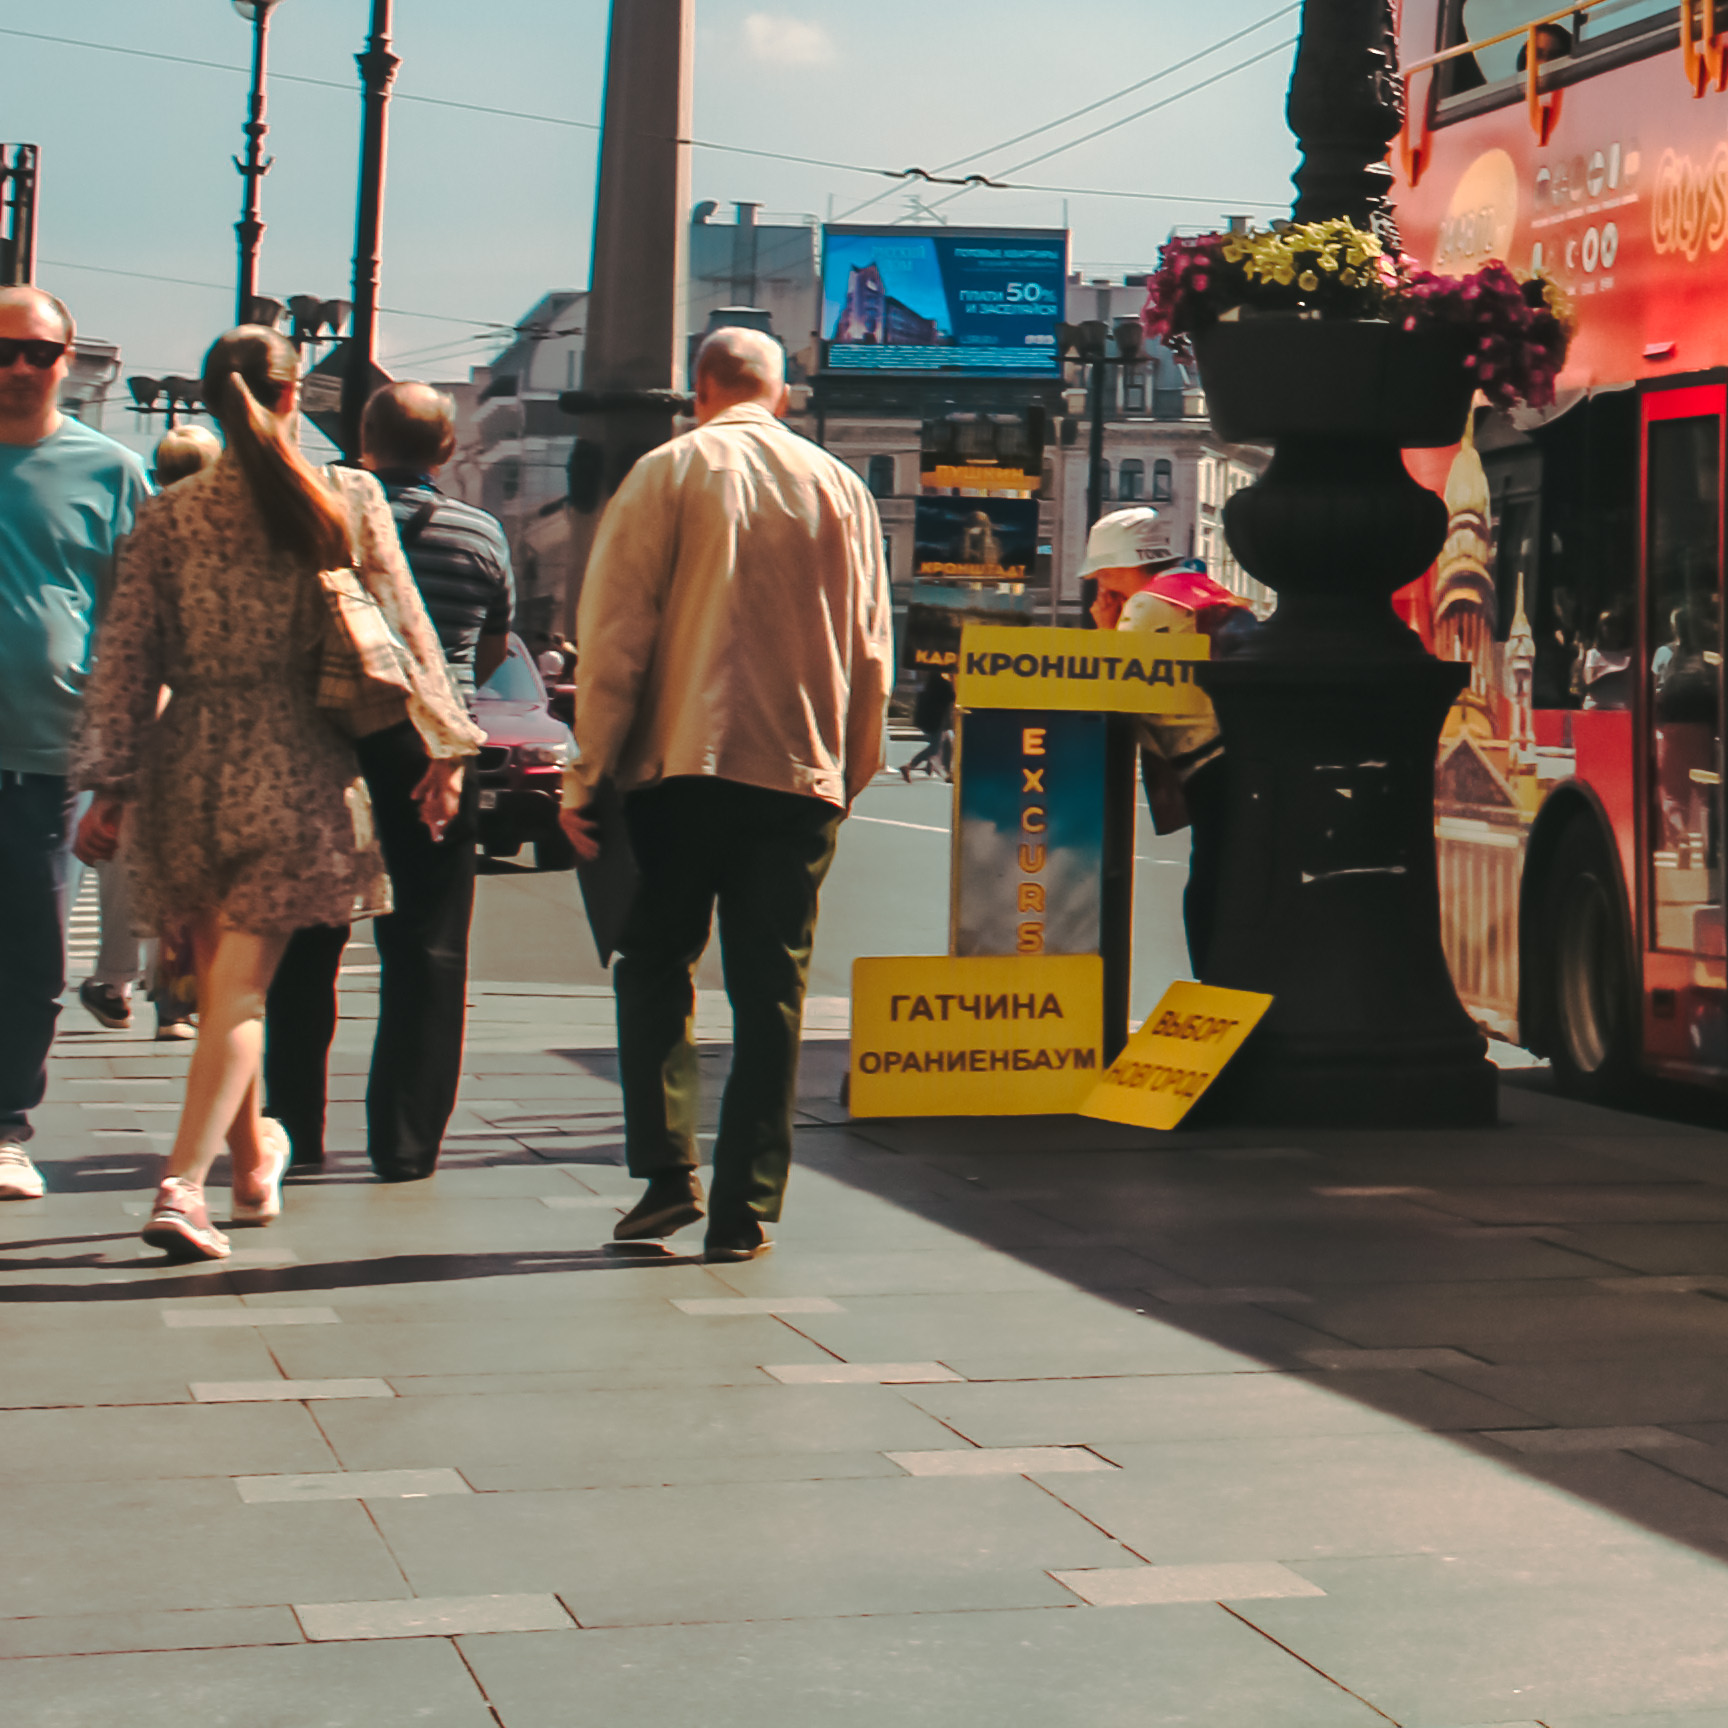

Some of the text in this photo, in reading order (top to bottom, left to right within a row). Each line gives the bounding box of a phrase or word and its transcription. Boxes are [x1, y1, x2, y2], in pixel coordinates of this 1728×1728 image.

[966, 651, 1197, 687] КРОНШТАДТ
[889, 993, 1064, 1022] ГАТЧИНА
[859, 1047, 1098, 1076] ОРАНИЕНБАУМ
